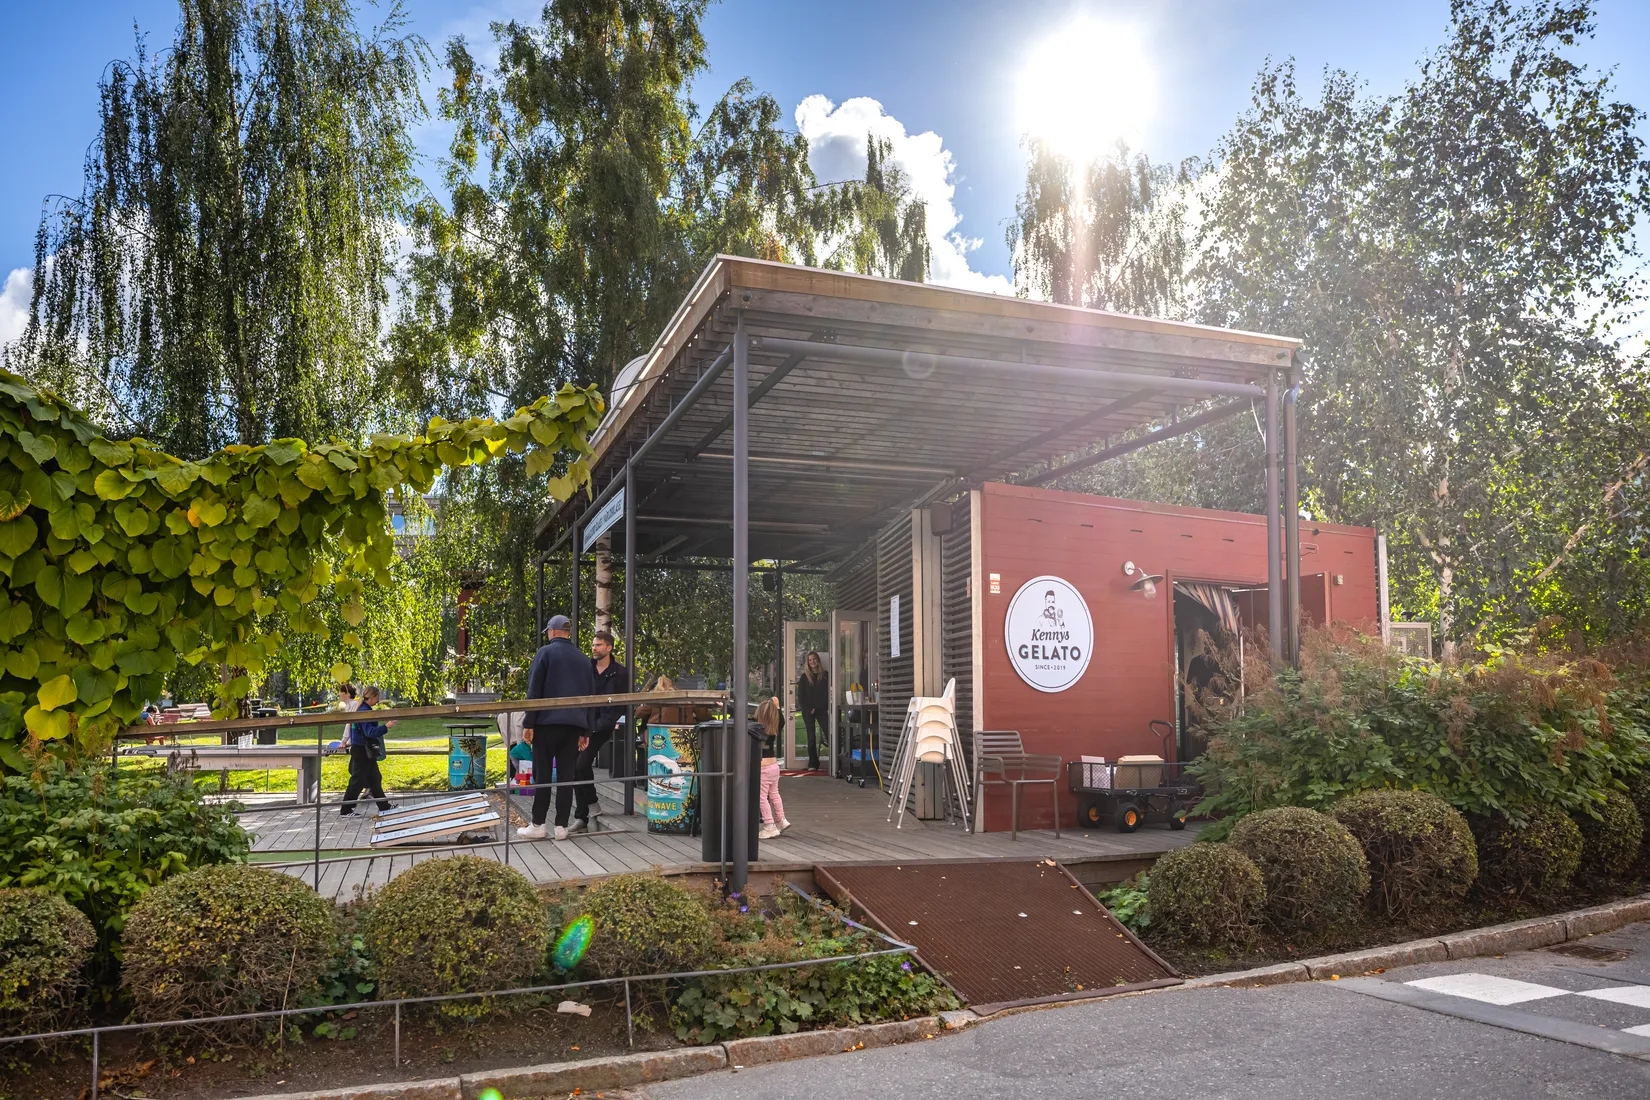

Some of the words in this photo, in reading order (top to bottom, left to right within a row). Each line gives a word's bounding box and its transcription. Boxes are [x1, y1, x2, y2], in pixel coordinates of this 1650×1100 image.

[1031, 628, 1070, 643] Kennys
[1018, 643, 1081, 661] GELATO
[655, 802, 677, 811] WAVE
